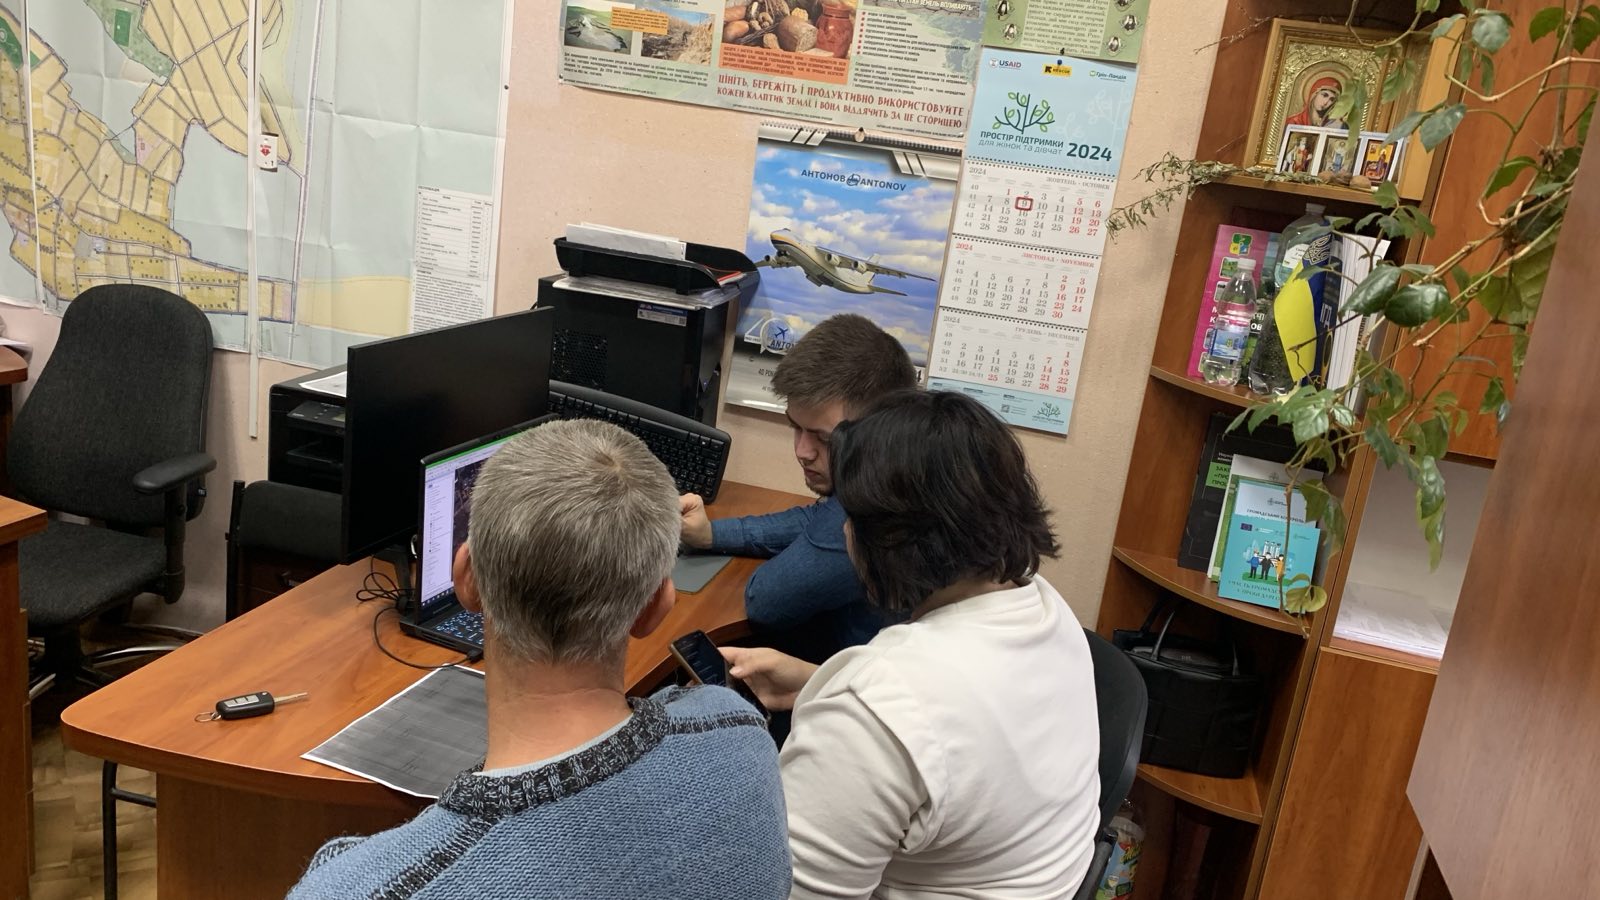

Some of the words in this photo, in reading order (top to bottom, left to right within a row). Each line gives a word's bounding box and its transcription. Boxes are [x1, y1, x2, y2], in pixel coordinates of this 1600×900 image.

[753, 79, 797, 94] БЕРЕЖІТЬ
[807, 87, 874, 104] ПРОДУКТИВНО
[878, 96, 964, 116] ВИКОРИСТОВУЙТЕ
[717, 87, 744, 98] КОЖЕН
[747, 91, 784, 103] КЛАПТИК
[820, 102, 840, 112] ВОНА
[843, 105, 888, 118] ВІДДЯЧИТЬ
[891, 111, 901, 120] ЗА
[904, 113, 913, 122] ЦЕ
[917, 115, 962, 128] СТОРИЦЕЮ
[980, 131, 1014, 141] ПРОСТІР
[1015, 135, 1064, 148] ПІДТРИМКИ
[996, 141, 1021, 150] жінок
[1034, 146, 1062, 155] дівчат
[1066, 143, 1112, 161] 2024
[801, 169, 846, 183] АНТОНОВ
[969, 167, 986, 175] 2024
[860, 178, 907, 191] ANTONOV
[984, 203, 993, 212] 14
[1001, 206, 1010, 214] 15
[1054, 214, 1063, 222] 18
[1088, 218, 1100, 226] 20
[1037, 202, 1047, 210] 10
[1090, 209, 1101, 217] 13
[981, 213, 990, 221] 21
[998, 215, 1009, 223] 22
[1015, 217, 1026, 226] 23
[1033, 220, 1043, 229] 24
[1051, 223, 1061, 231] 25
[1068, 225, 1080, 233] 26
[1086, 228, 1097, 236] 27
[996, 225, 1007, 233] 29
[1013, 227, 1025, 235] 30
[1004, 284, 1013, 292] 13
[1038, 290, 1048, 298] 15
[1001, 293, 1012, 301] 20
[1018, 296, 1028, 304] 21
[1036, 298, 1047, 307] 22
[1053, 302, 1064, 310] 23
[1017, 305, 1027, 313] 28
[1051, 310, 1062, 318] 30
[1042, 365, 1052, 373] 14
[1060, 368, 1069, 376] 15
